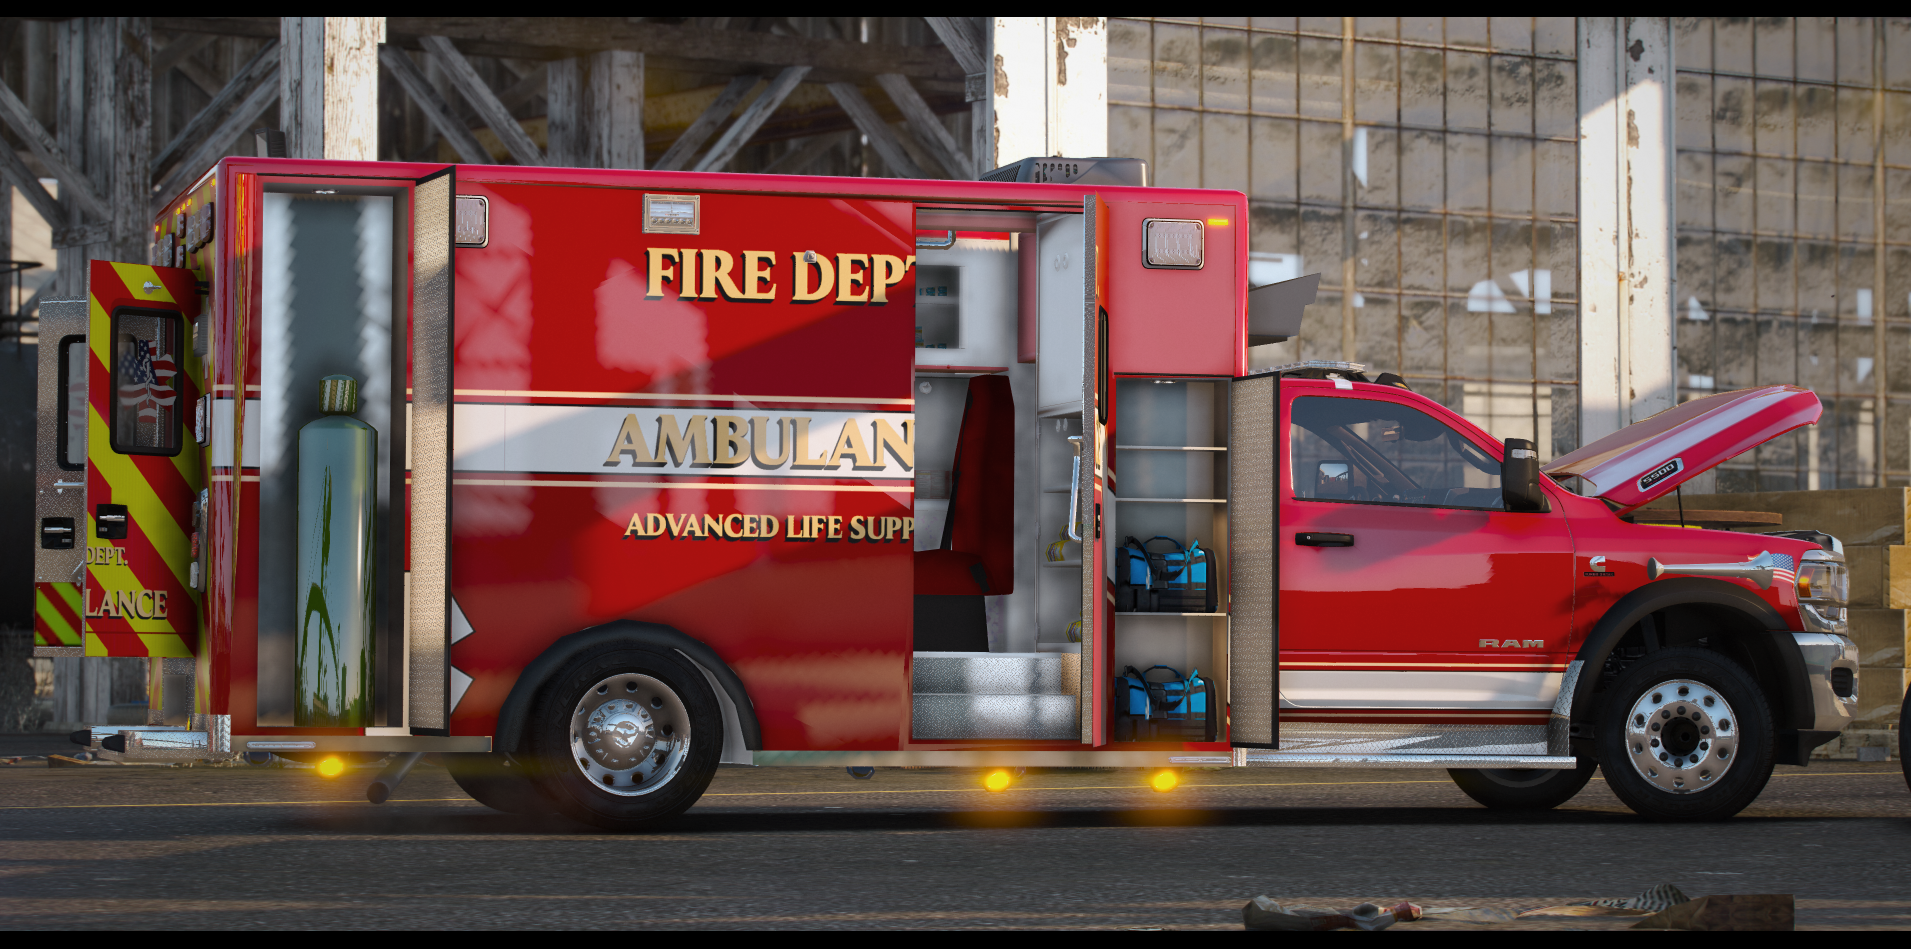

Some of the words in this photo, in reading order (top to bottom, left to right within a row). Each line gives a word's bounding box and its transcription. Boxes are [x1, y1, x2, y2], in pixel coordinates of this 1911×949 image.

[644, 247, 777, 304] FIRE
[602, 413, 915, 472] AMBULAN
[622, 512, 780, 542] ADVANCED
[784, 514, 843, 543] LIFE
[847, 515, 914, 544] SUPP
[86, 588, 168, 620] LANCE
[1478, 638, 1545, 649] RAM
